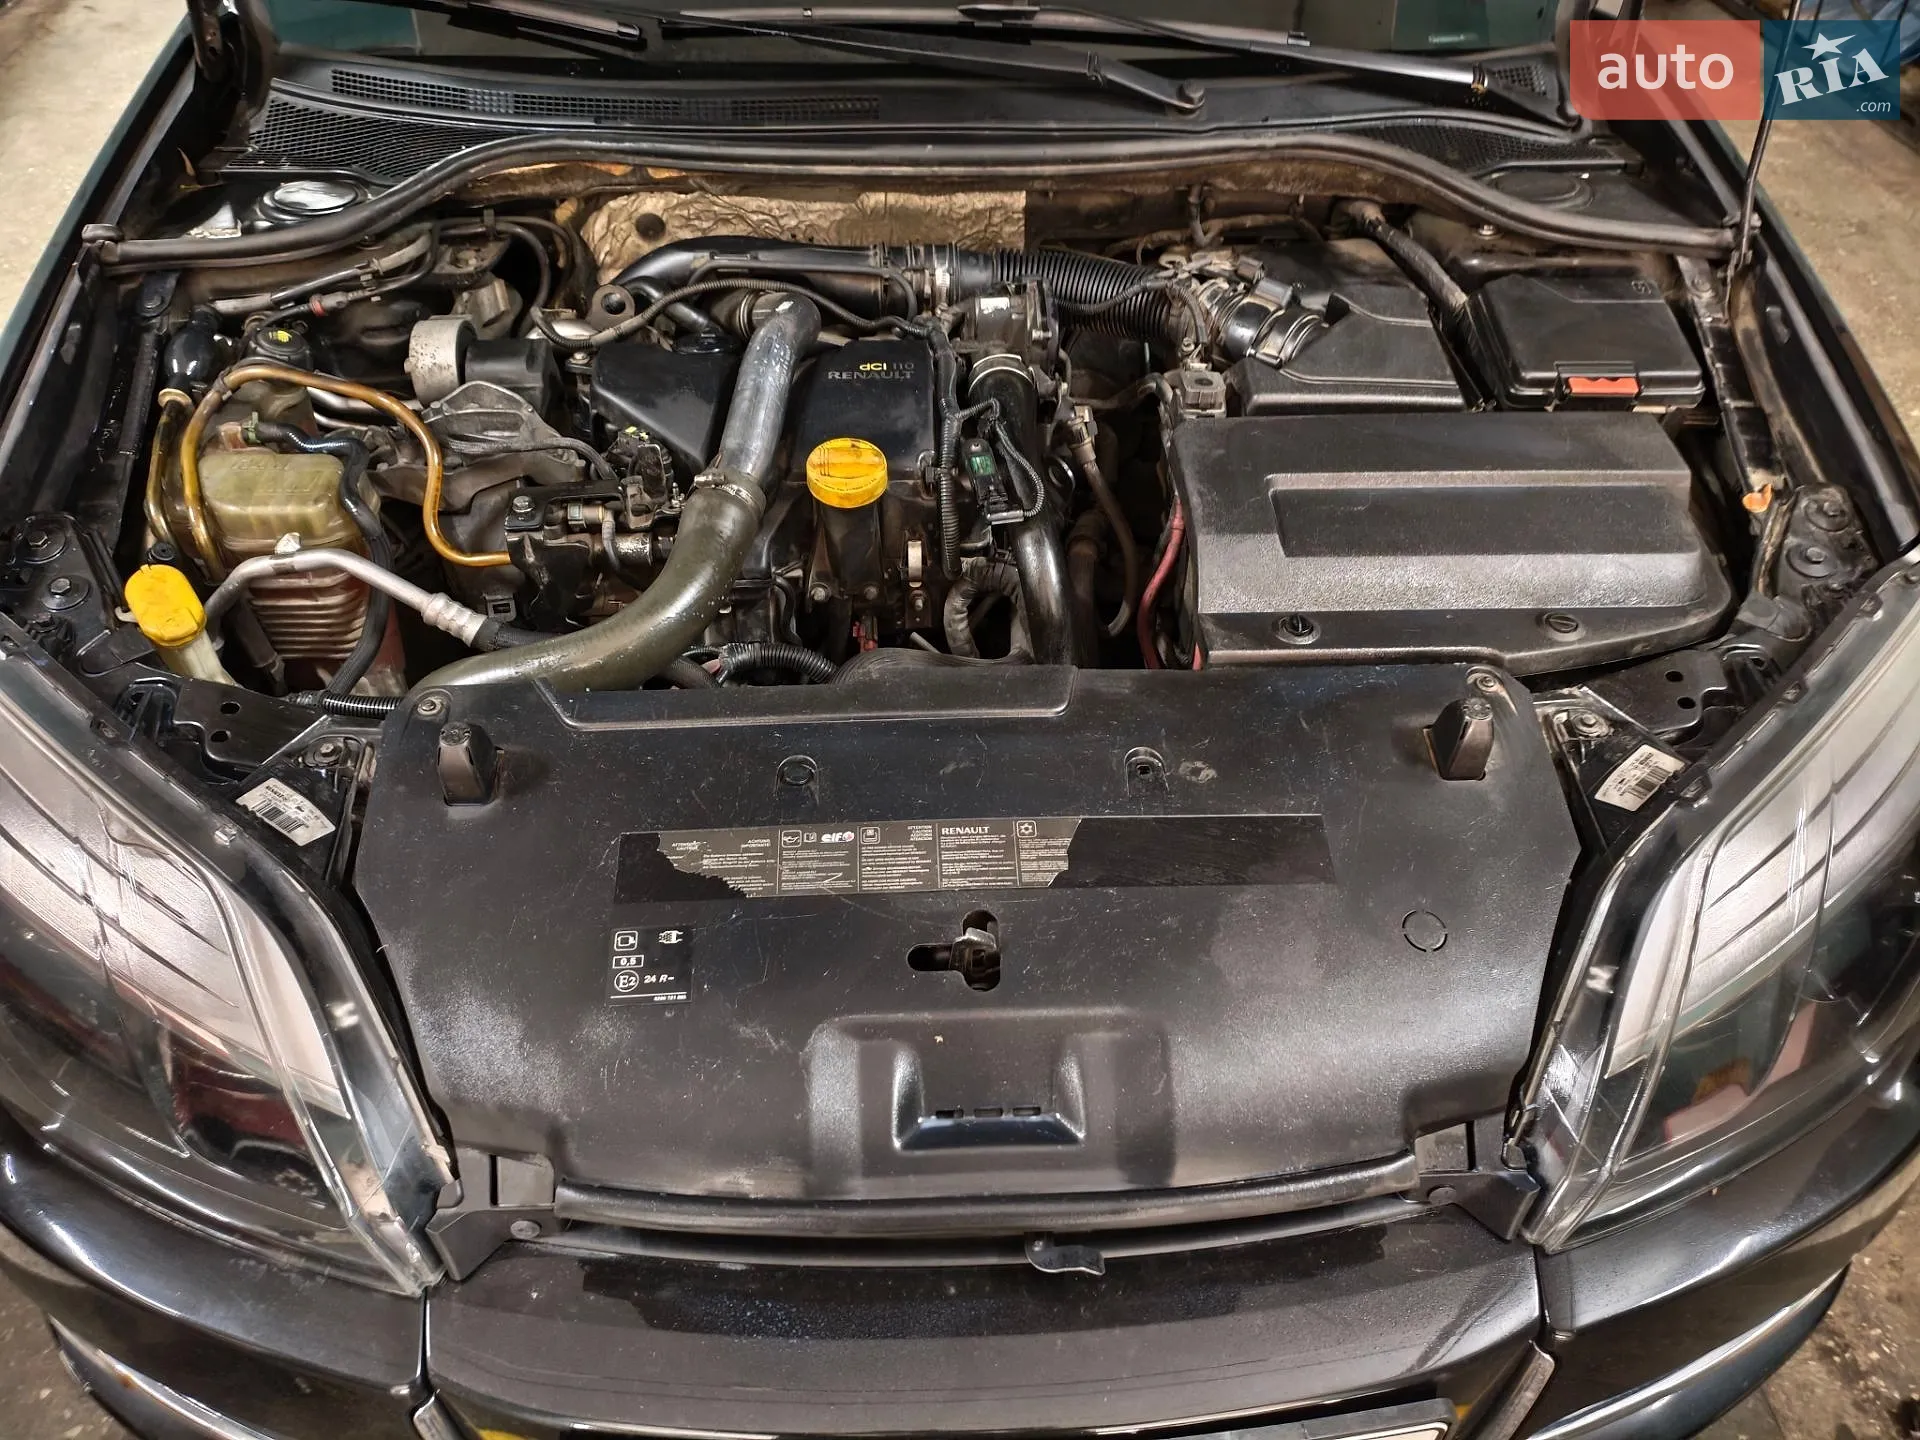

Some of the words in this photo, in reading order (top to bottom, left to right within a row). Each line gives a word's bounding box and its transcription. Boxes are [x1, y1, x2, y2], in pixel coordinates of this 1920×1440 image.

[827, 371, 915, 380] RENAULT
[941, 826, 990, 835] RENAULT
[618, 975, 637, 988] E2
[643, 974, 657, 983] 24
